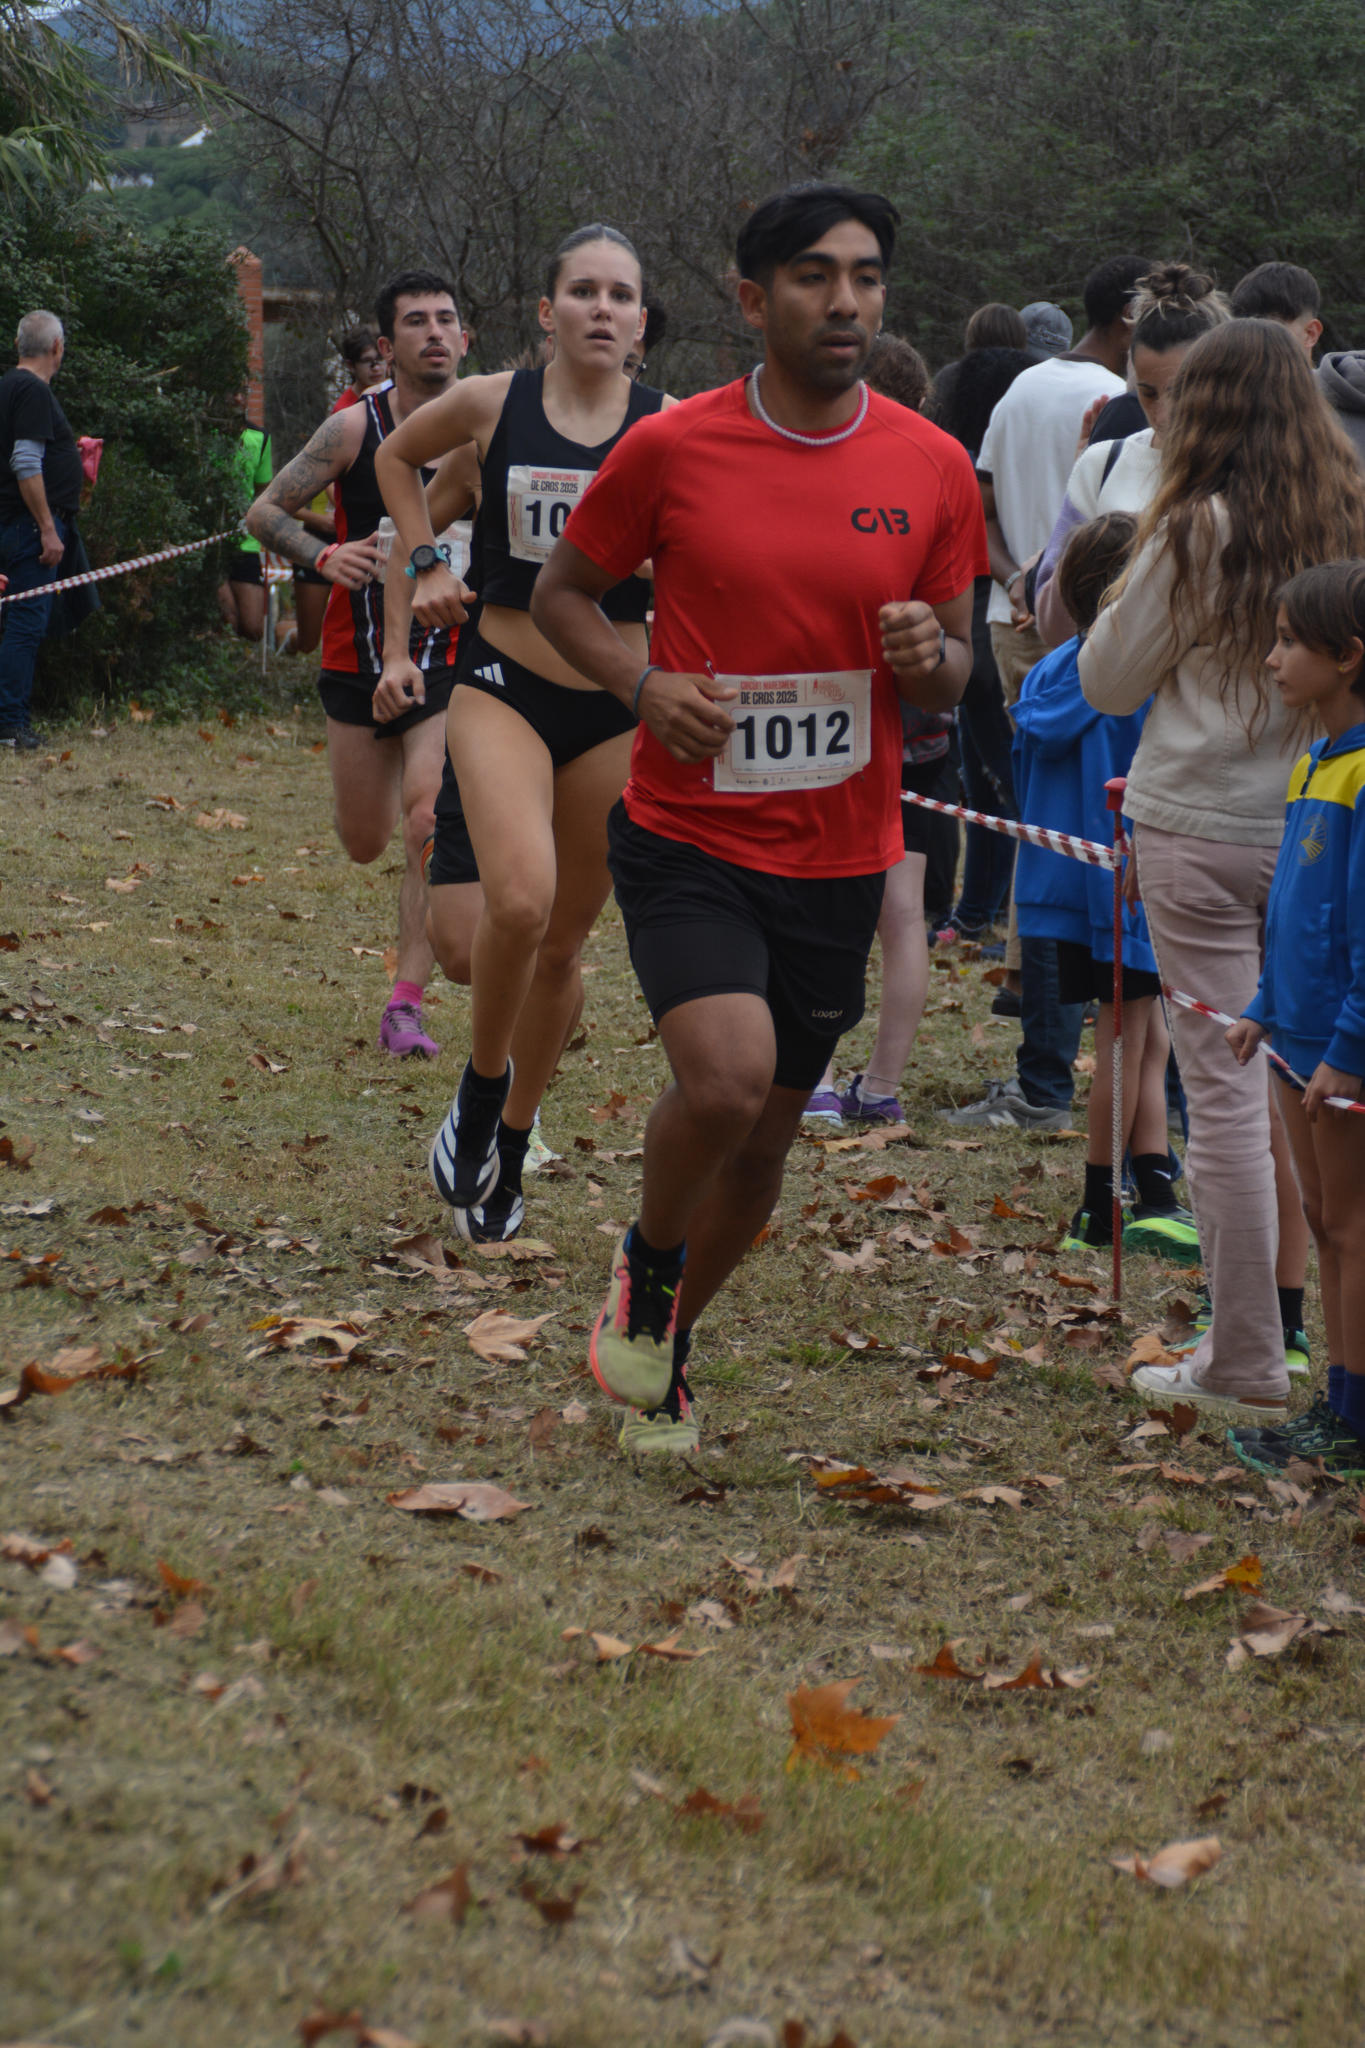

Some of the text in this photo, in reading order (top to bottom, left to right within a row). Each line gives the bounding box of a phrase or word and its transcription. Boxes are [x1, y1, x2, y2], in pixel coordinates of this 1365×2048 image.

[531, 480, 578, 494] DE CROS 2025
[740, 690, 798, 705] DE CROS 2025
[736, 710, 851, 760] 1012
